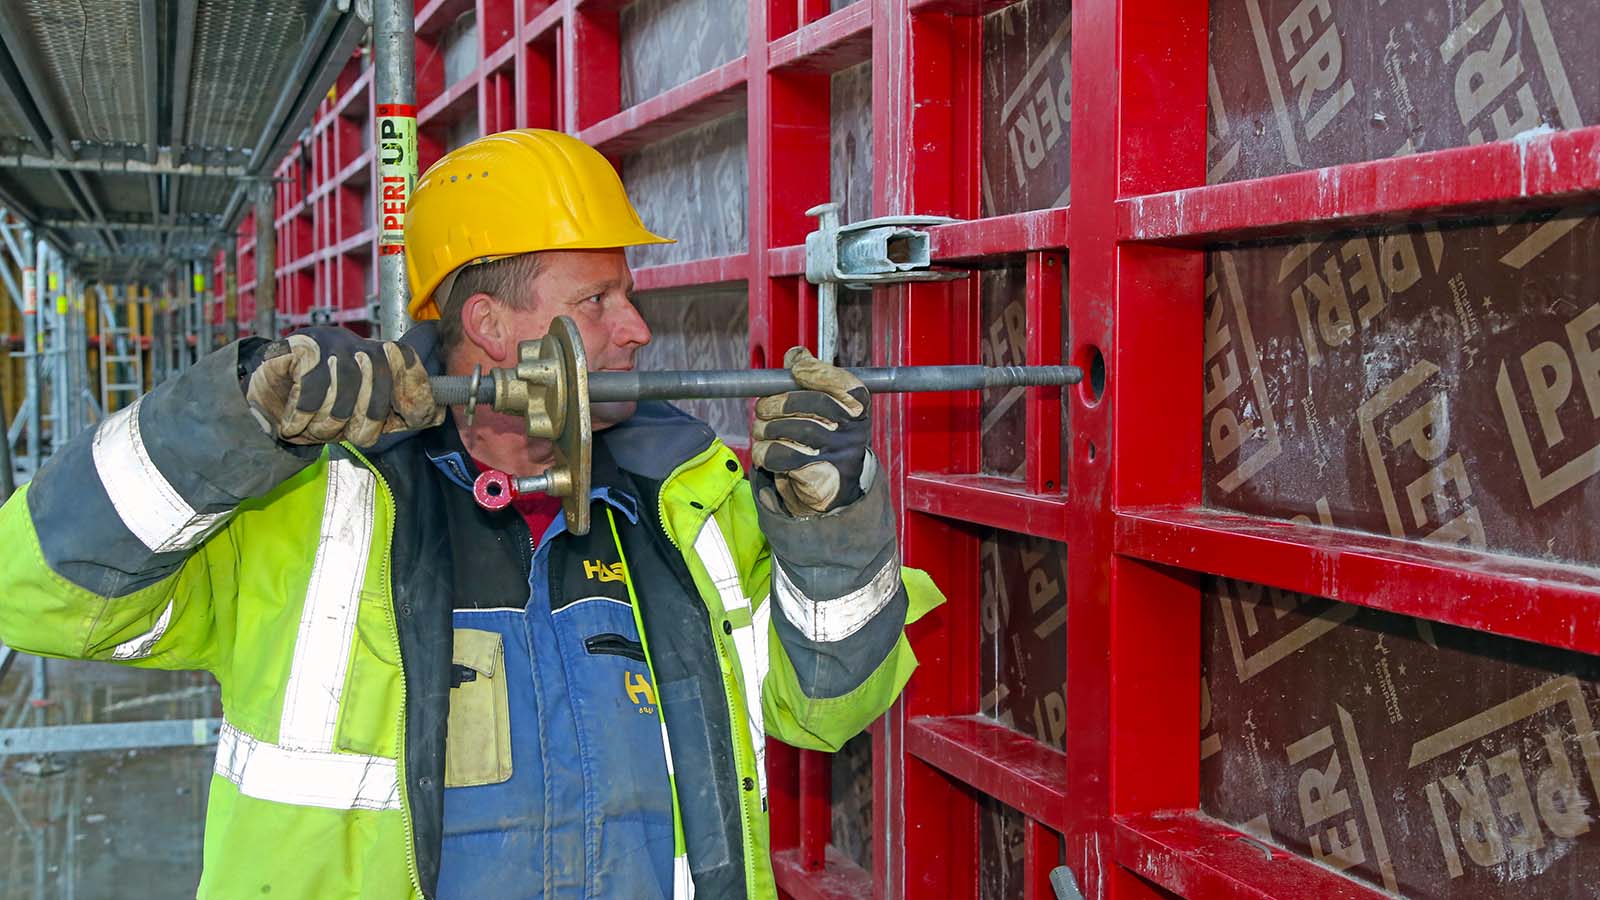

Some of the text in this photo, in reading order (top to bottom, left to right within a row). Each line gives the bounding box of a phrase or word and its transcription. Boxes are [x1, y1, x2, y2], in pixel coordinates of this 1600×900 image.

[381, 119, 405, 230] PERI UP
[1291, 234, 1422, 366] PERI
[1425, 730, 1591, 879] PERI
